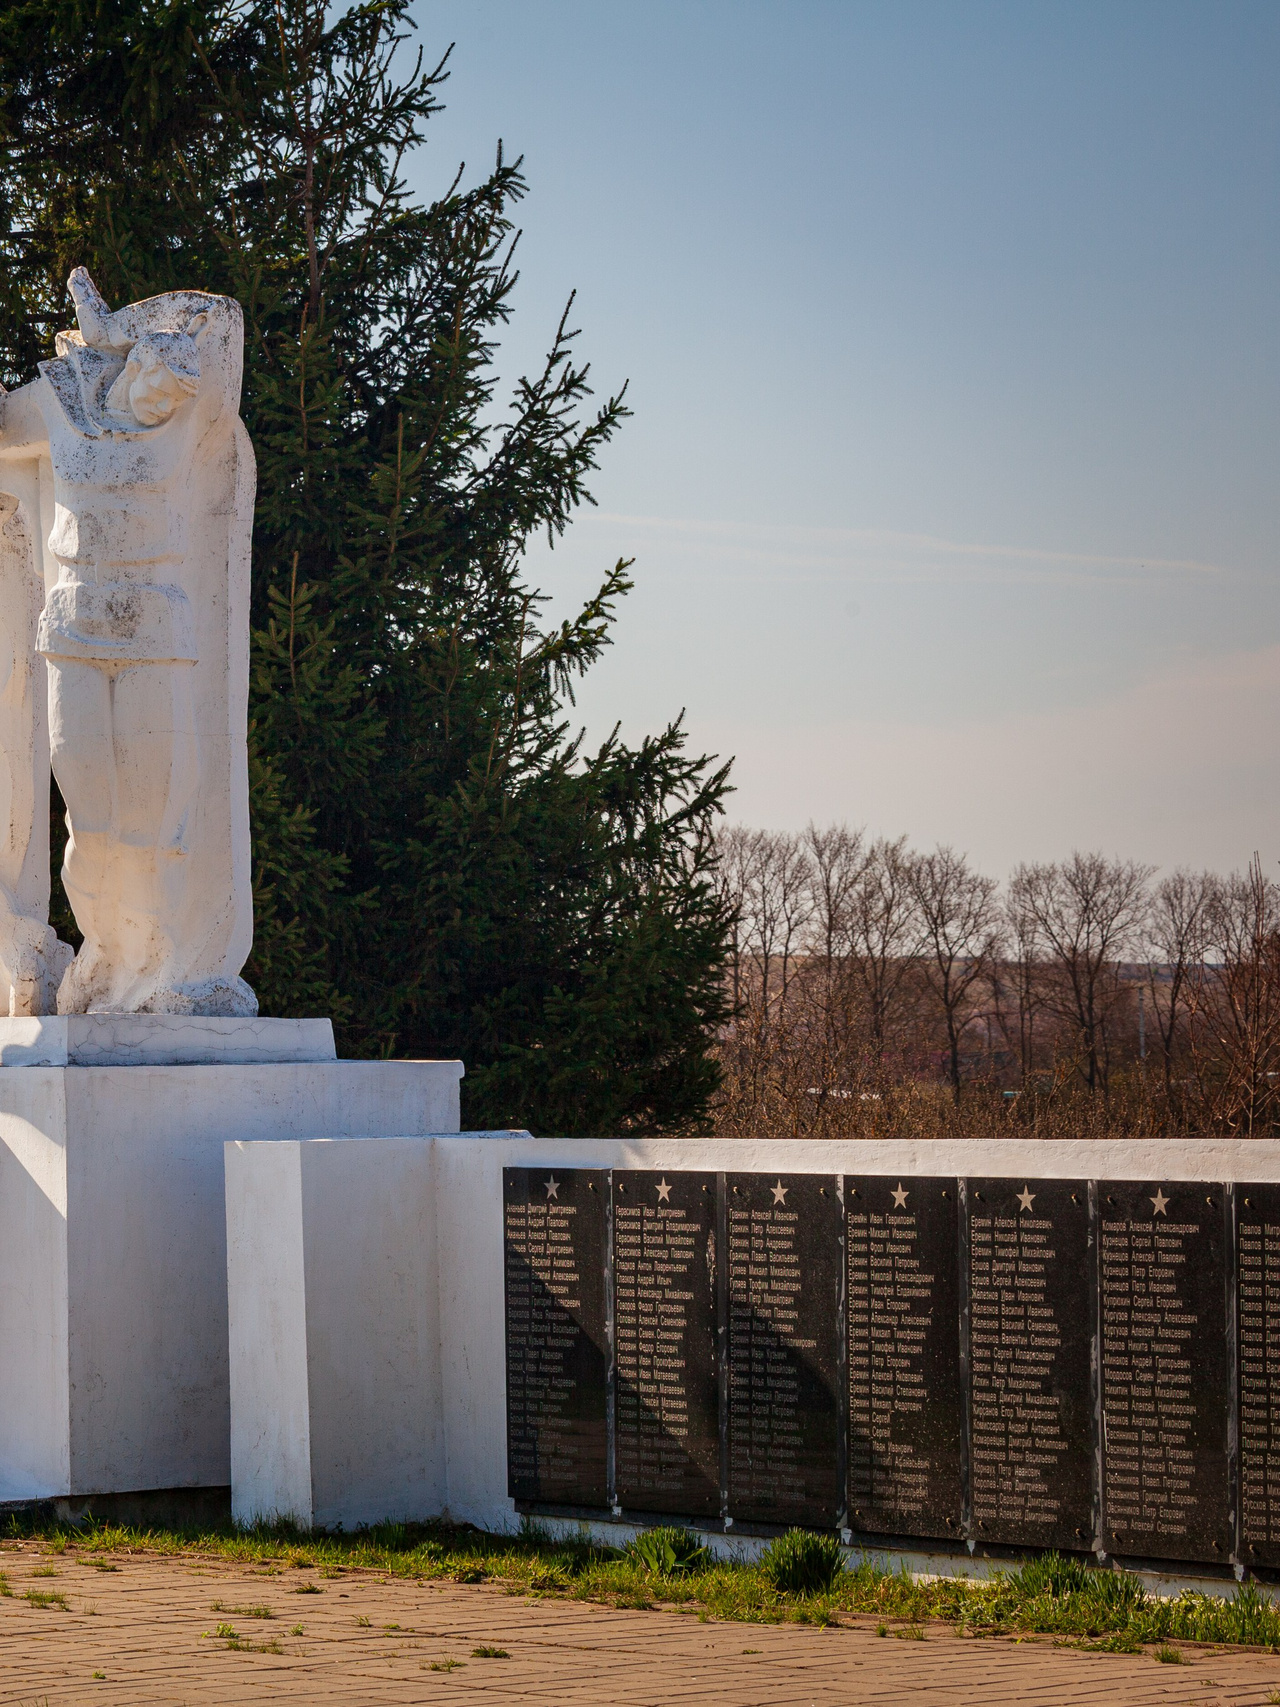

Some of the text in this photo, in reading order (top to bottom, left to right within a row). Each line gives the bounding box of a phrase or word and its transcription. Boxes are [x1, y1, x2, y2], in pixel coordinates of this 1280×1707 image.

[1102, 1220, 1199, 1235] Комаров Алексей Александрович
[1240, 1223, 1261, 1234] Павлов
[971, 1230, 1046, 1243] Еремин Николай Иванович
[1102, 1235, 1182, 1248] Кузнецов Сергей Павлович
[1240, 1238, 1261, 1250] Павлов
[971, 1245, 1055, 1259] Еремин Тимофей Михайлович
[1103, 1265, 1174, 1279] Кузнецов Петр Егорович
[1240, 1269, 1261, 1280] Павлов
[1103, 1280, 1176, 1294] Кузнецов Петр Иванович
[1240, 1284, 1262, 1296] Павлов
[1241, 1375, 1266, 1390] Полунин
[1242, 1391, 1266, 1405] Полунин
